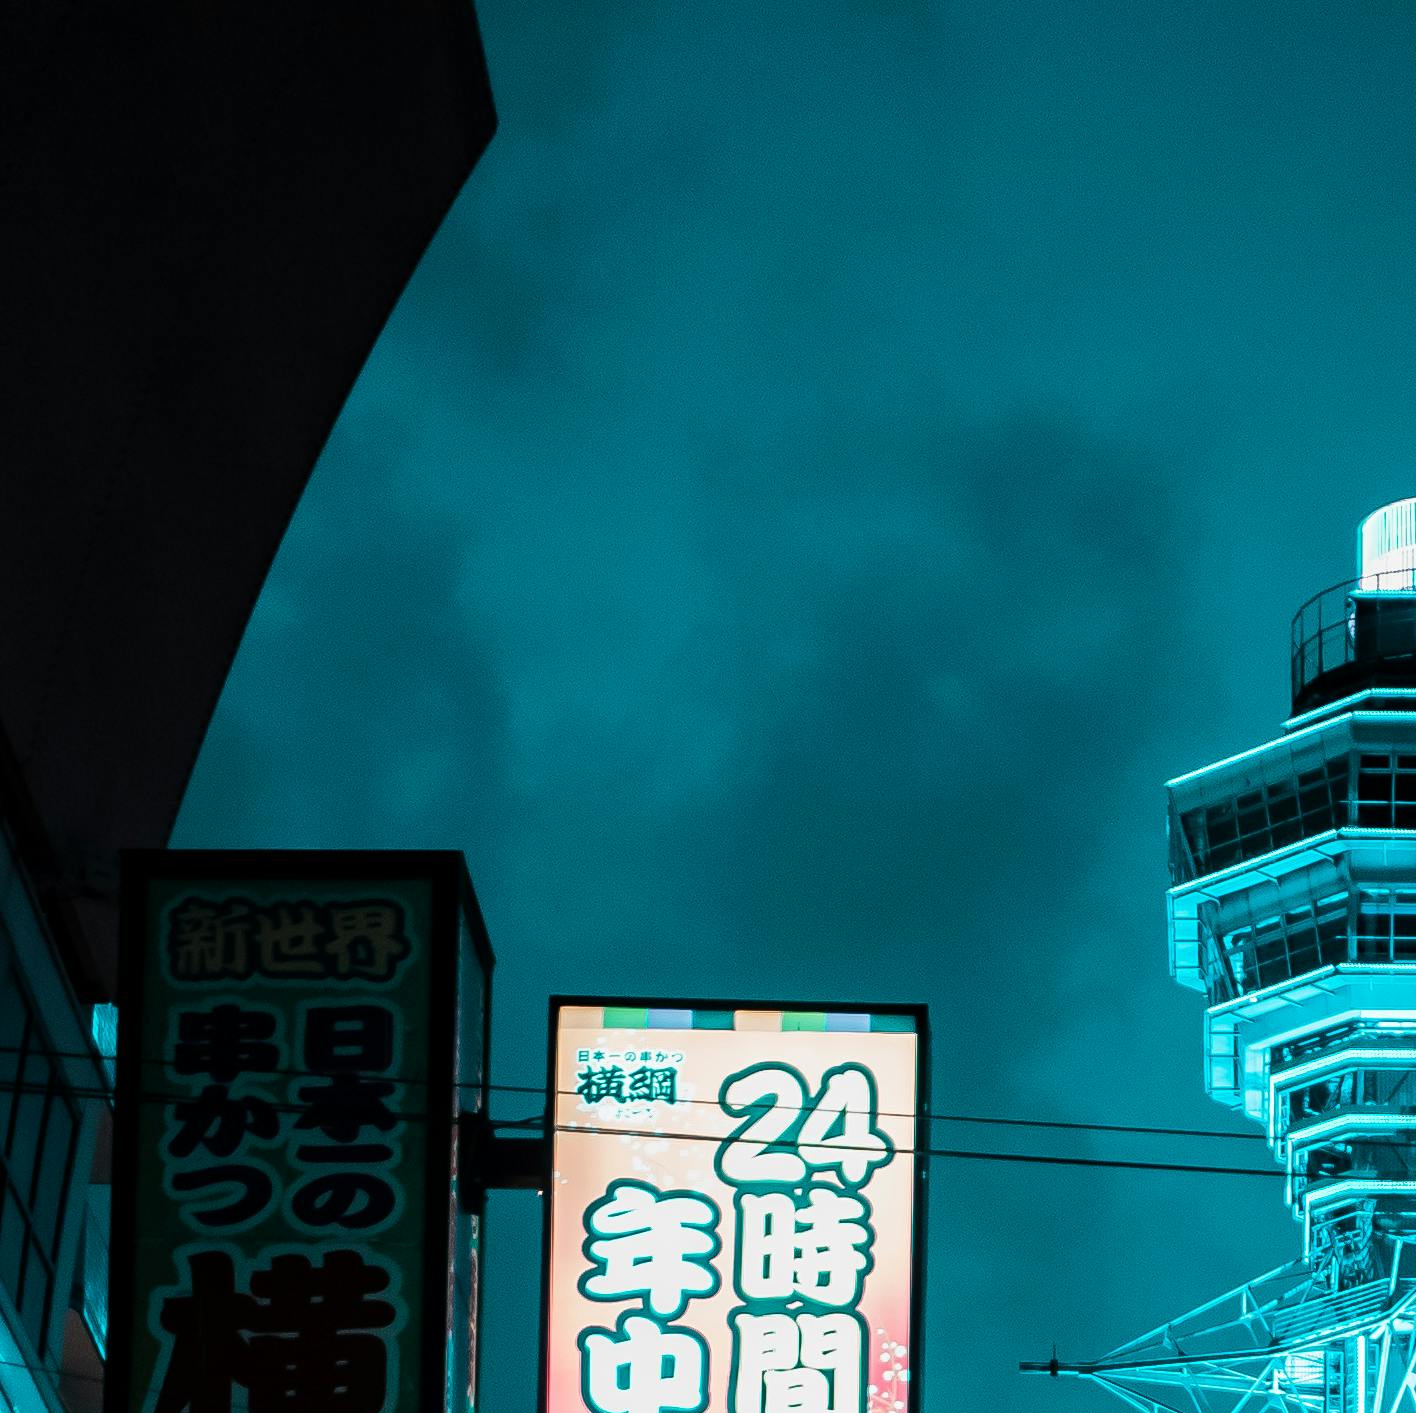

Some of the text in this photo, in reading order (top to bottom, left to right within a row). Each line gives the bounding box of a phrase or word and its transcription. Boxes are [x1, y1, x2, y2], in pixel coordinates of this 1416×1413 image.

[172, 896, 404, 978] 新世界
[576, 1065, 677, 1105] 横綱
[577, 1050, 685, 1063] 日本一の串かつ
[168, 1003, 281, 1230] 串かつ
[288, 1003, 398, 1232] 日本一の
